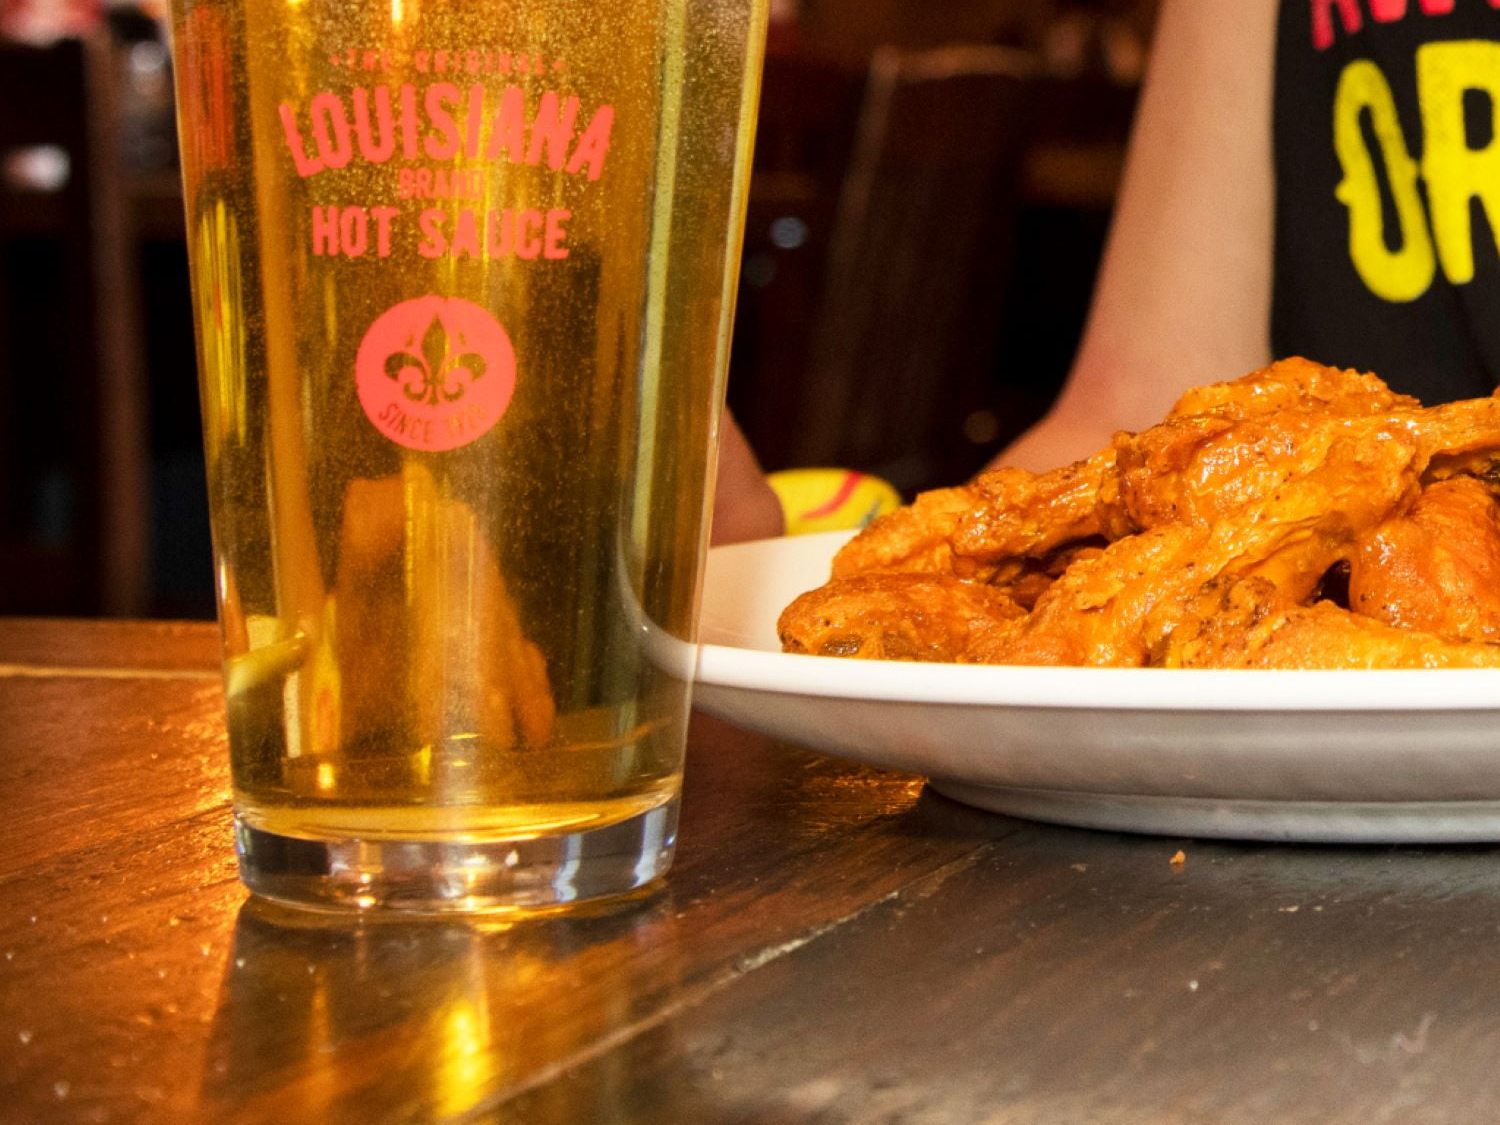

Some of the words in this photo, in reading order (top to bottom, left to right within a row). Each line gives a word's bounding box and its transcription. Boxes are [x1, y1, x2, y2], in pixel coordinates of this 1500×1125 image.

[278, 81, 616, 182] LOUISIANA
[399, 166, 485, 200] BRAND
[311, 205, 399, 259] HOT
[417, 207, 573, 261] SAUCE
[378, 402, 435, 444] SINCE
